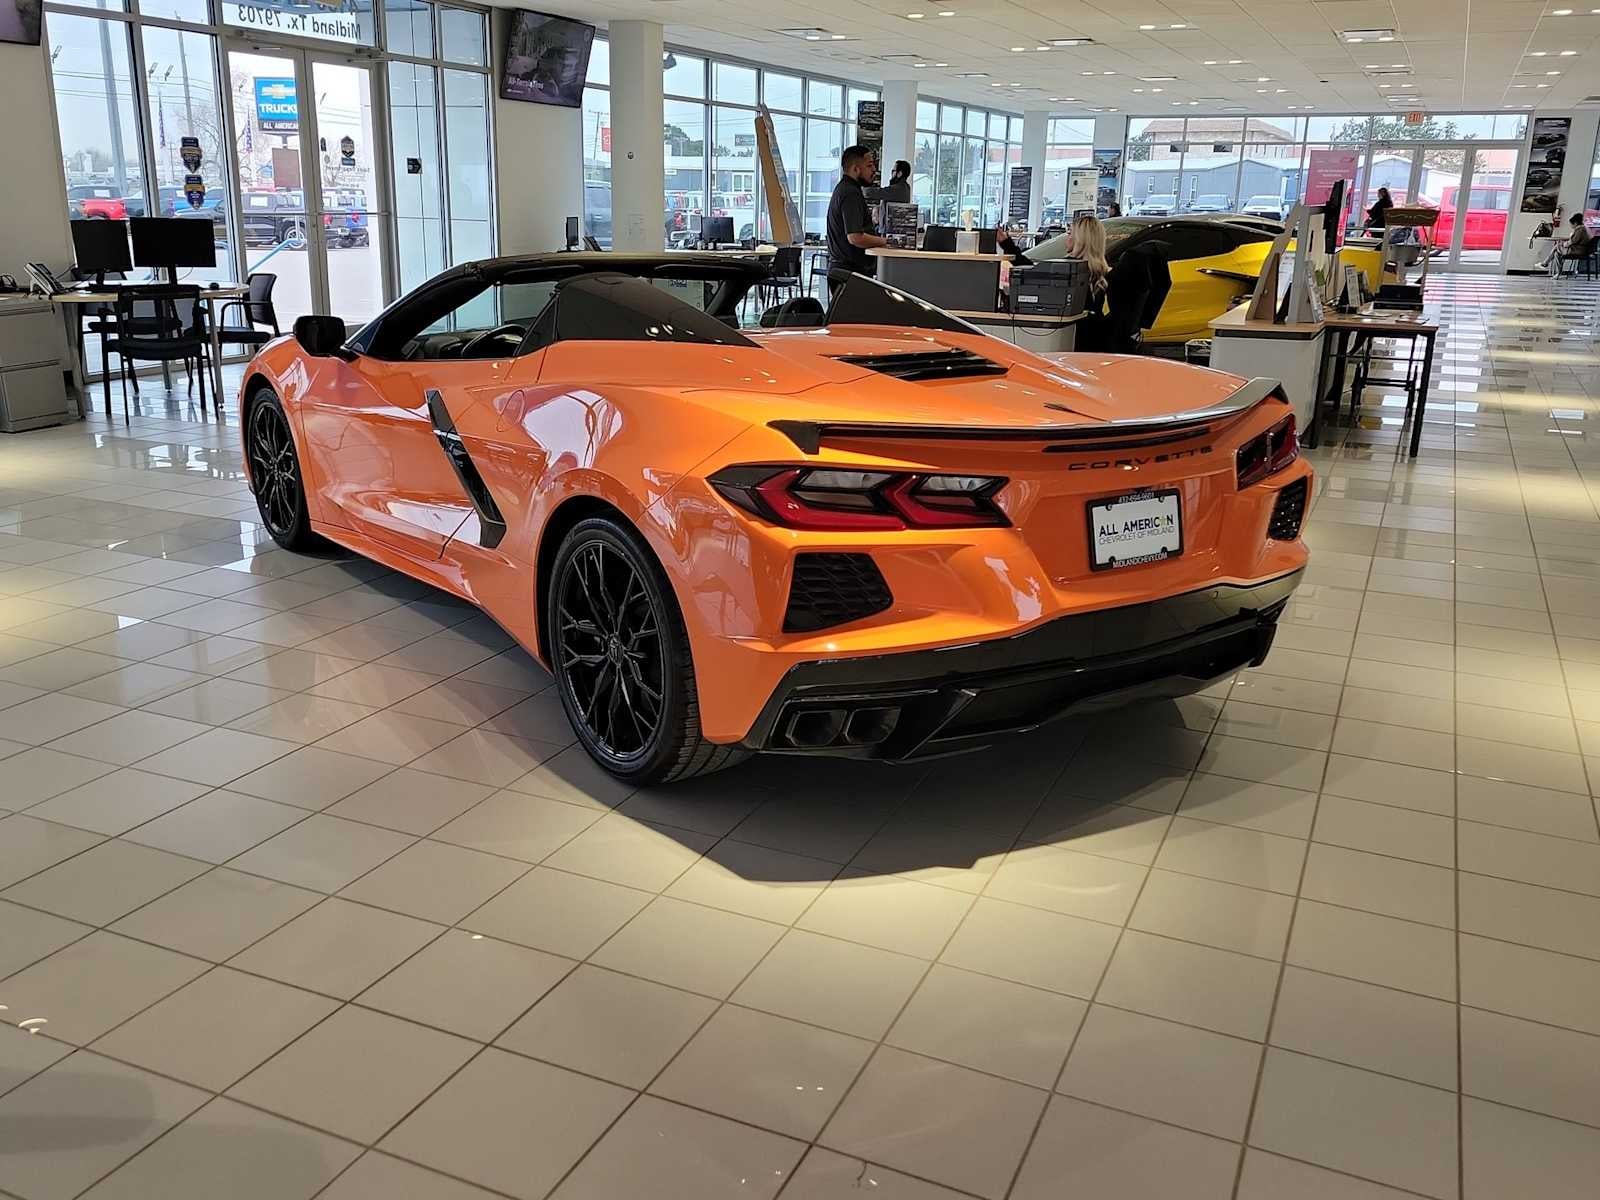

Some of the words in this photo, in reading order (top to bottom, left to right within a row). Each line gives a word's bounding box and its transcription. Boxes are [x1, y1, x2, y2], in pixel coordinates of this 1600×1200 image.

[1069, 446, 1212, 470] CORVETTE
[1099, 523, 1118, 537] ALL
[1099, 533, 1136, 545] CHEVROLET
[1137, 531, 1146, 539] OF
[1146, 526, 1174, 537] MIDLAND
